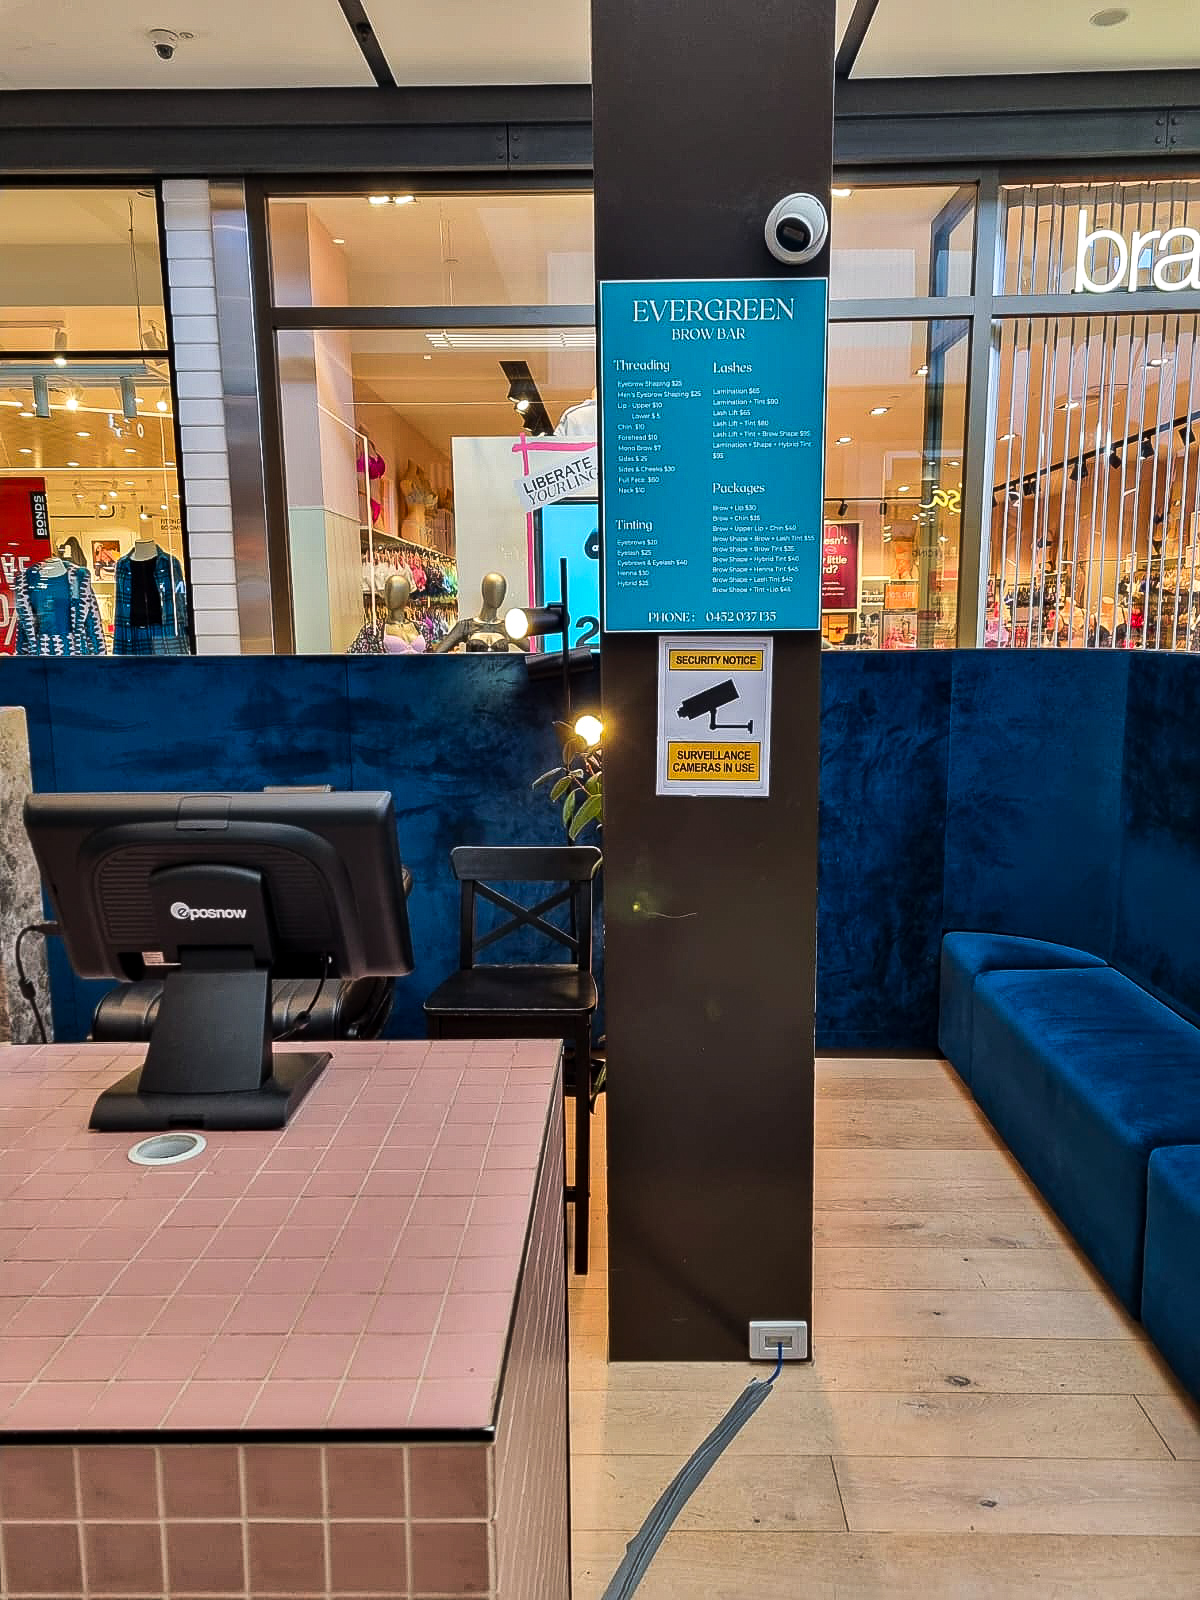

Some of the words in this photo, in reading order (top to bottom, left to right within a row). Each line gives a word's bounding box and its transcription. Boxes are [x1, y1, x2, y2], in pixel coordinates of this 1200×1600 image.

[633, 298, 794, 322] EVERGREEN
[672, 328, 714, 340] BROW
[718, 328, 746, 340] BAR
[613, 360, 670, 372] Threading
[713, 361, 752, 373] Lashes
[523, 457, 592, 494] LIBERATE
[528, 482, 566, 504] YOUR
[713, 482, 765, 495] Packages
[33, 495, 47, 536] BONDS
[616, 520, 652, 532] Tinting
[706, 612, 734, 622] 0452
[736, 612, 757, 622] 037
[760, 612, 776, 622] 135
[676, 656, 721, 665] SECURITY
[723, 656, 757, 664] NOTICE
[677, 750, 752, 760] SURVEILLANCE
[673, 763, 721, 773] CAMERAS
[724, 763, 732, 772] IN
[736, 763, 755, 773] USE
